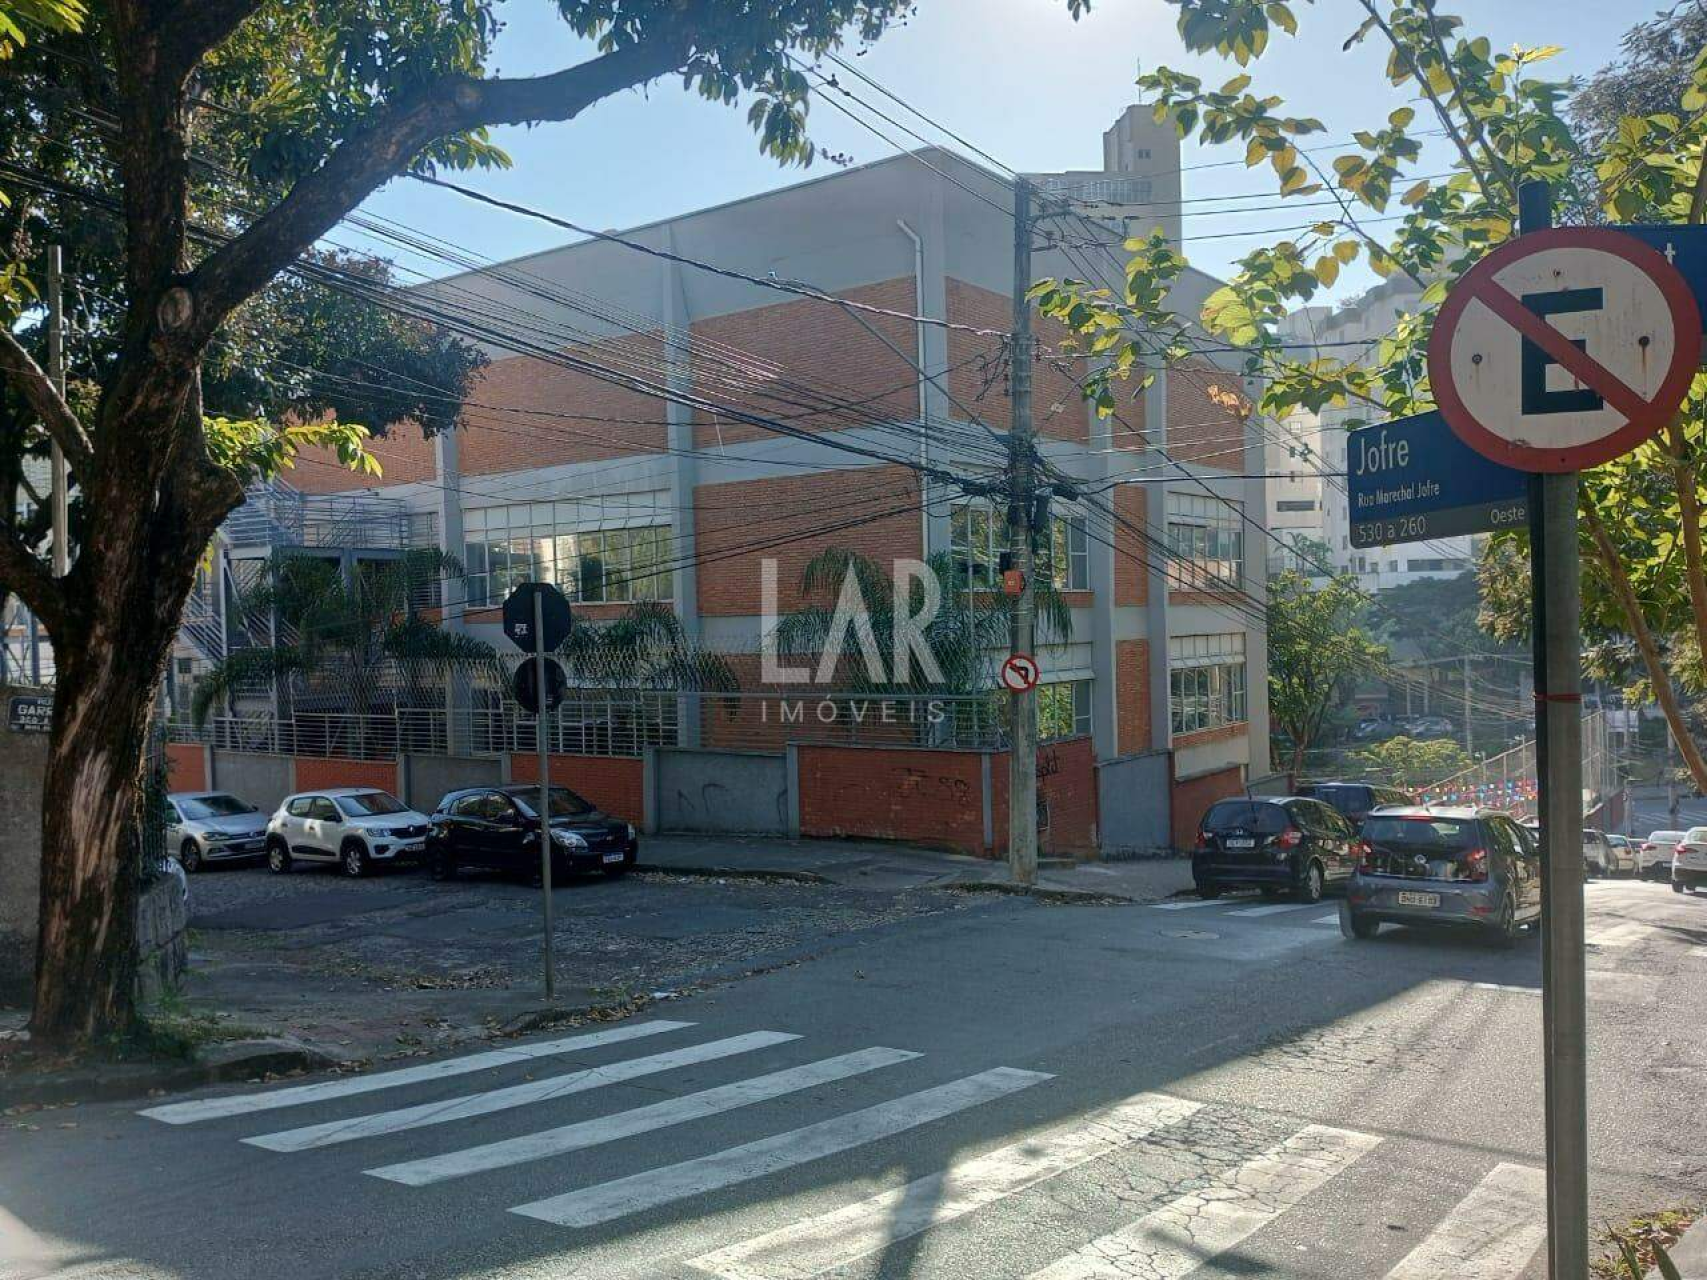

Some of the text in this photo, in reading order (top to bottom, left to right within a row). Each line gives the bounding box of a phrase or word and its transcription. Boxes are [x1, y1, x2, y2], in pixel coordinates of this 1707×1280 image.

[1521, 287, 1604, 416] E
[1356, 430, 1409, 476] Jofre
[1376, 483, 1415, 504] Marechal
[1416, 479, 1440, 498] Jofre
[1358, 515, 1425, 542] 530 a 260
[1490, 507, 1525, 524] Oeste
